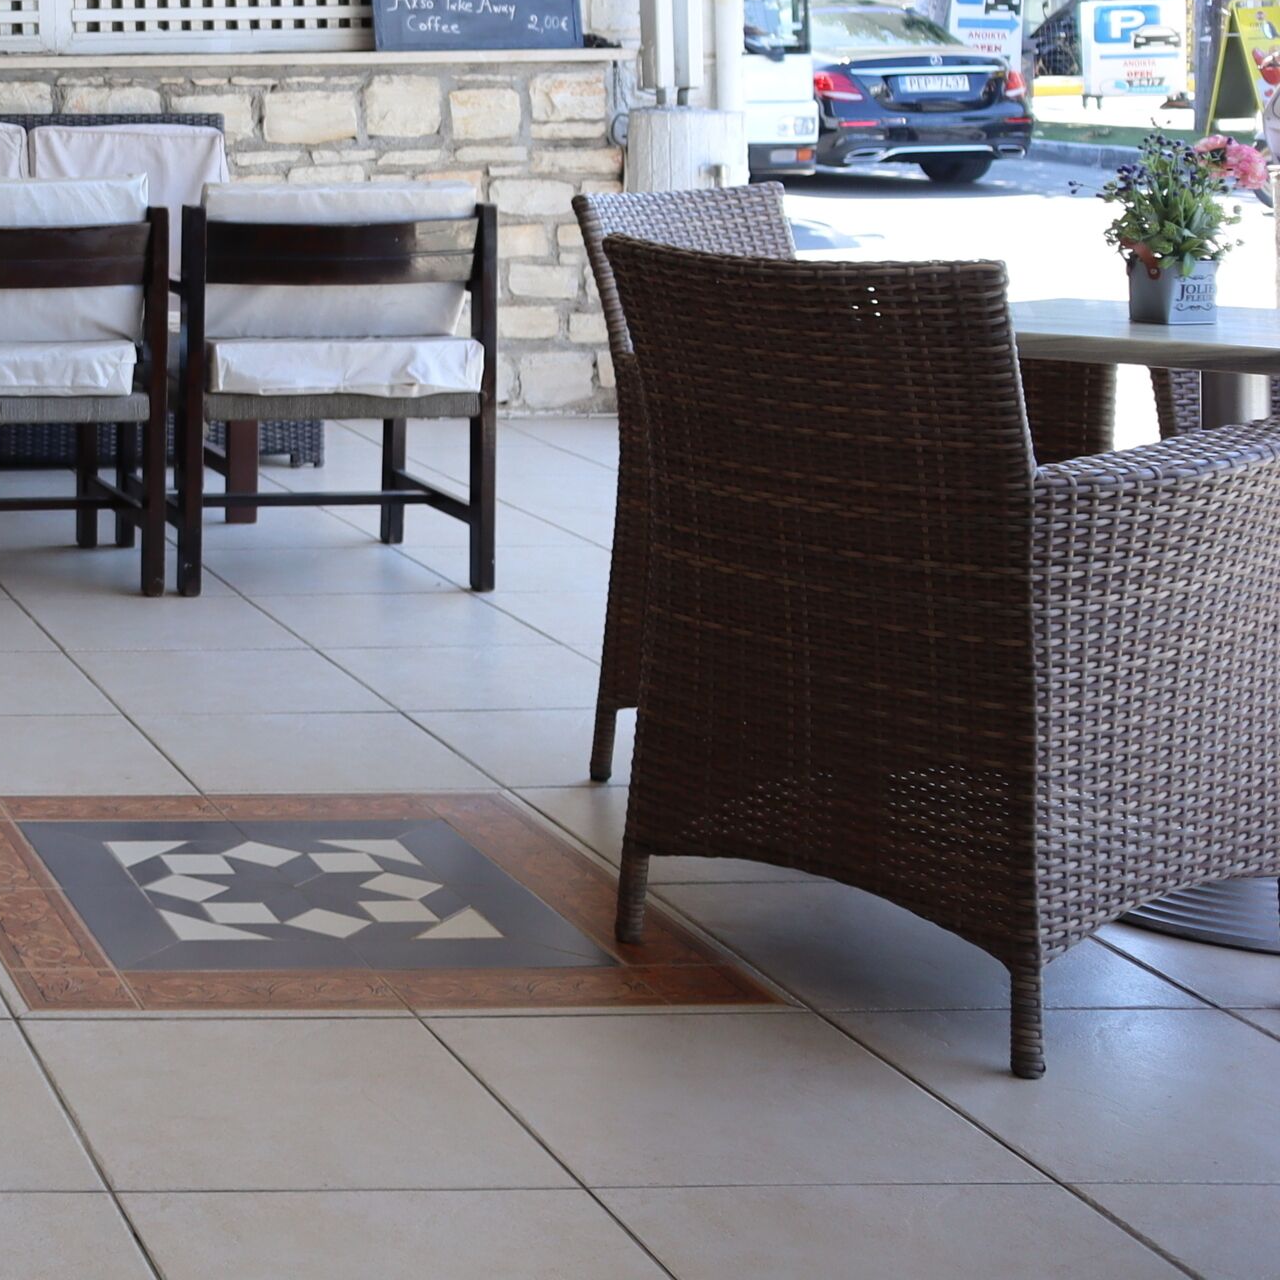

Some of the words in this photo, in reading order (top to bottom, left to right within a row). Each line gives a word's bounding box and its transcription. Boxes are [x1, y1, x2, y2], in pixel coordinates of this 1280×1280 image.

[407, 14, 461, 34] Coffee
[527, 14, 568, 34] 2,00€
[1110, 9, 1146, 39] P
